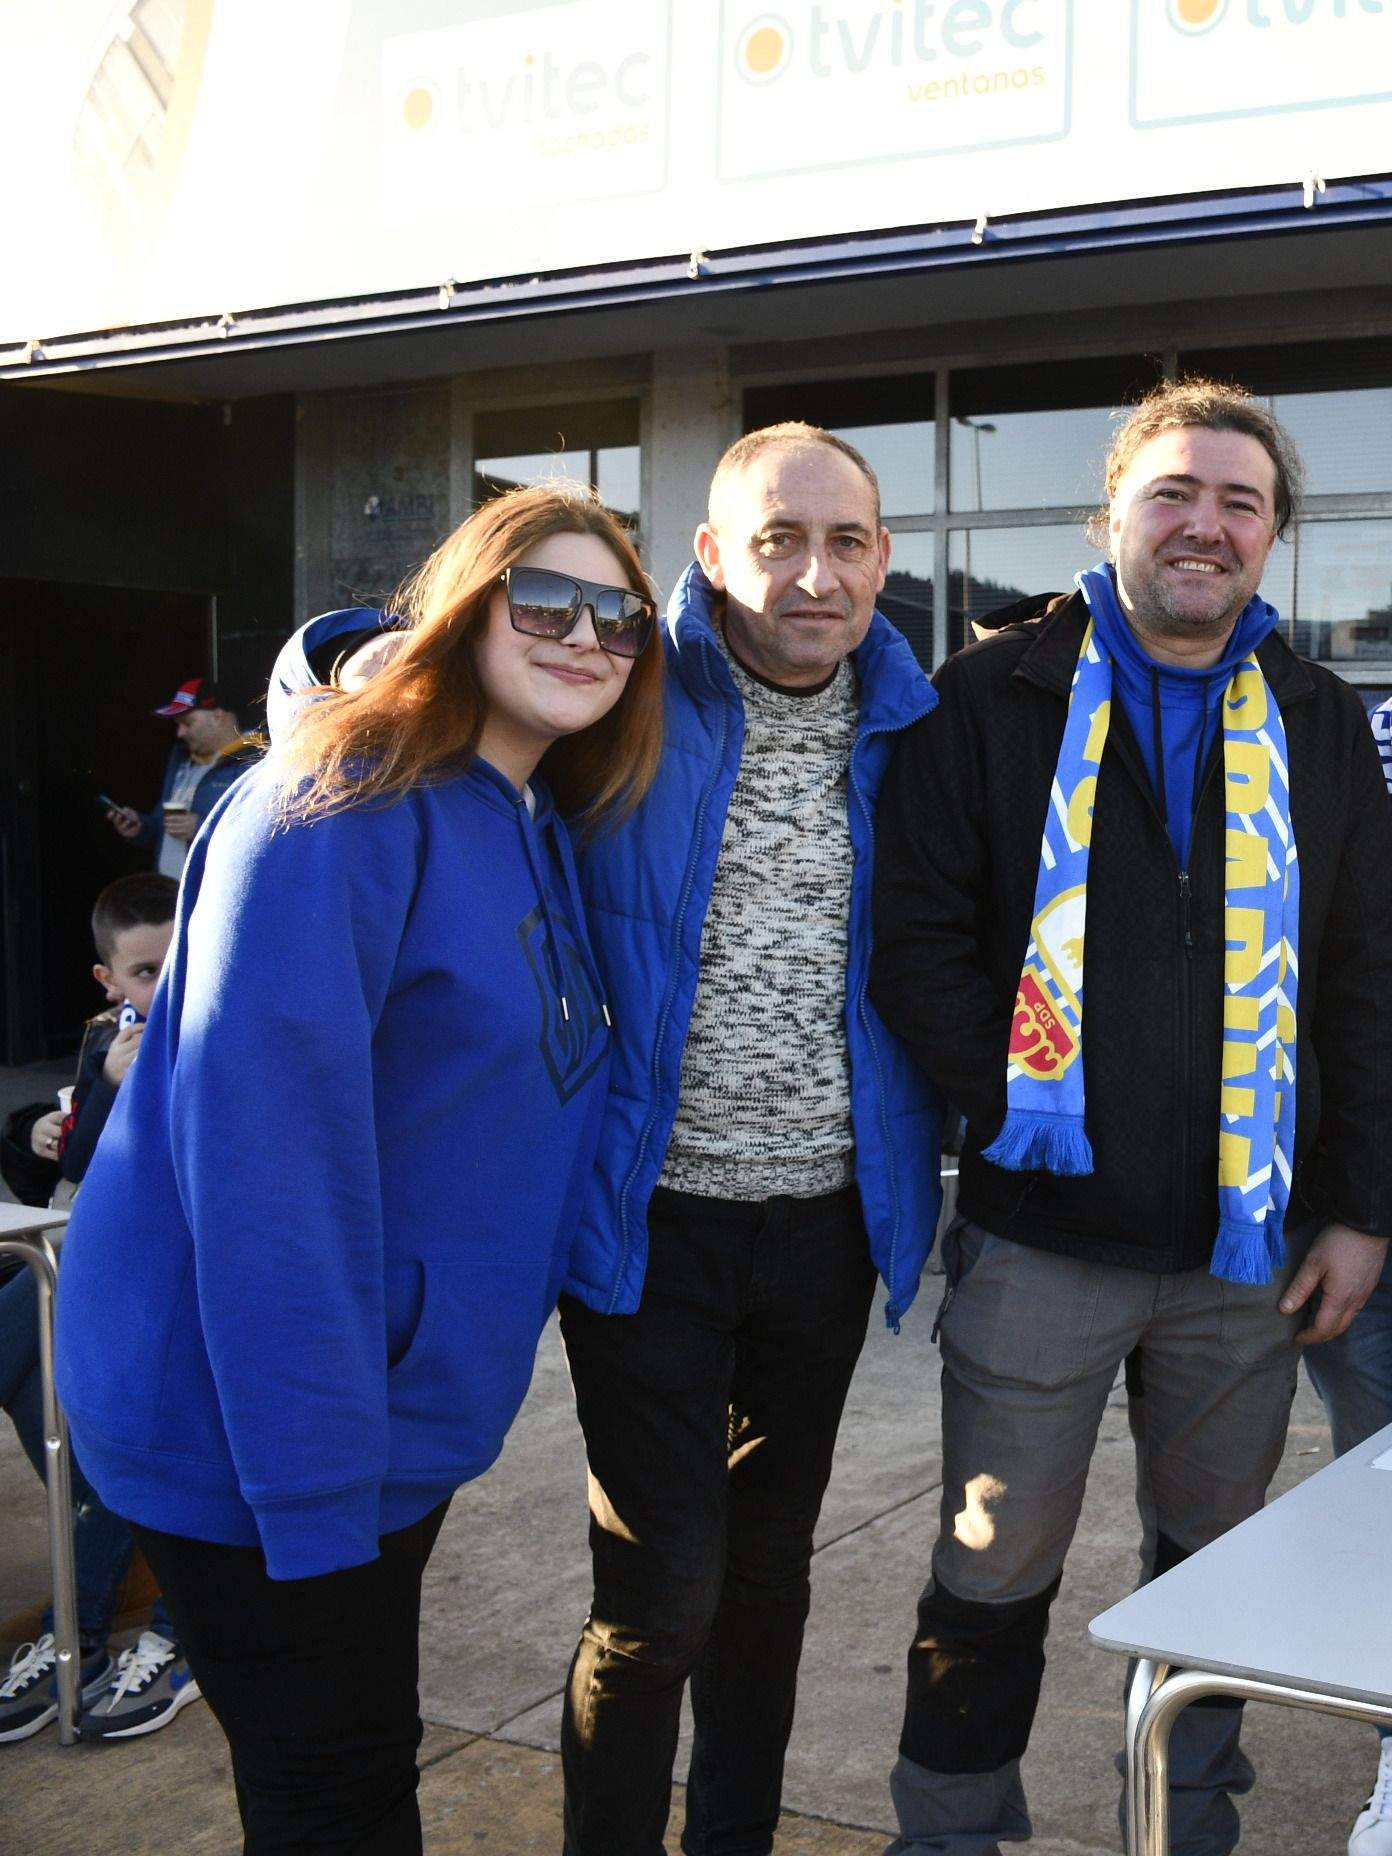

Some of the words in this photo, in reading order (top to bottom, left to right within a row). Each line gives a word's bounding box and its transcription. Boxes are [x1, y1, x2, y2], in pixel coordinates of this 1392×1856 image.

[810, 0, 1045, 78] tvitec
[457, 50, 651, 134] tvitec
[907, 64, 1047, 102] ventanas
[1034, 1001, 1056, 1031] SDP
